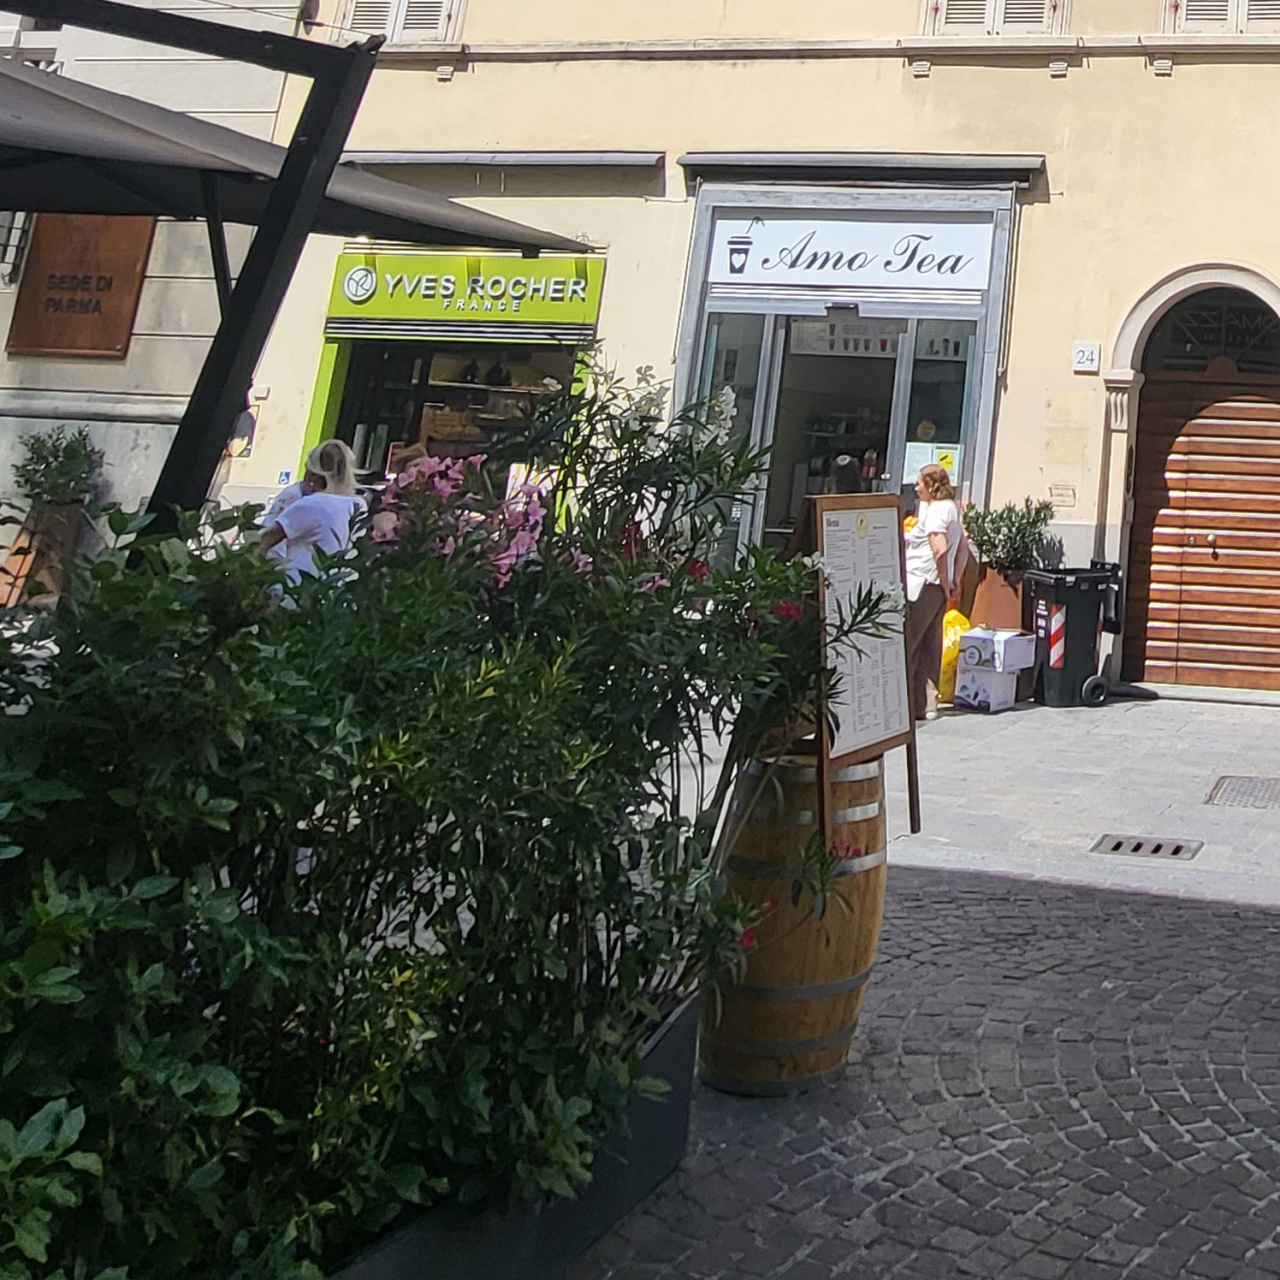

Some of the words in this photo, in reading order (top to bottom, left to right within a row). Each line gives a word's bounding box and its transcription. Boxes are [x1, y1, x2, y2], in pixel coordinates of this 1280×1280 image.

[761, 230, 879, 271] Amo
[883, 233, 974, 275] Tea
[48, 274, 91, 291] SEDE
[95, 275, 114, 292] DI
[385, 273, 457, 299] YVES
[466, 276, 587, 302] ROCHER
[44, 297, 102, 313] PARMA
[443, 299, 522, 312] FRANCE
[1075, 348, 1097, 366] 24
